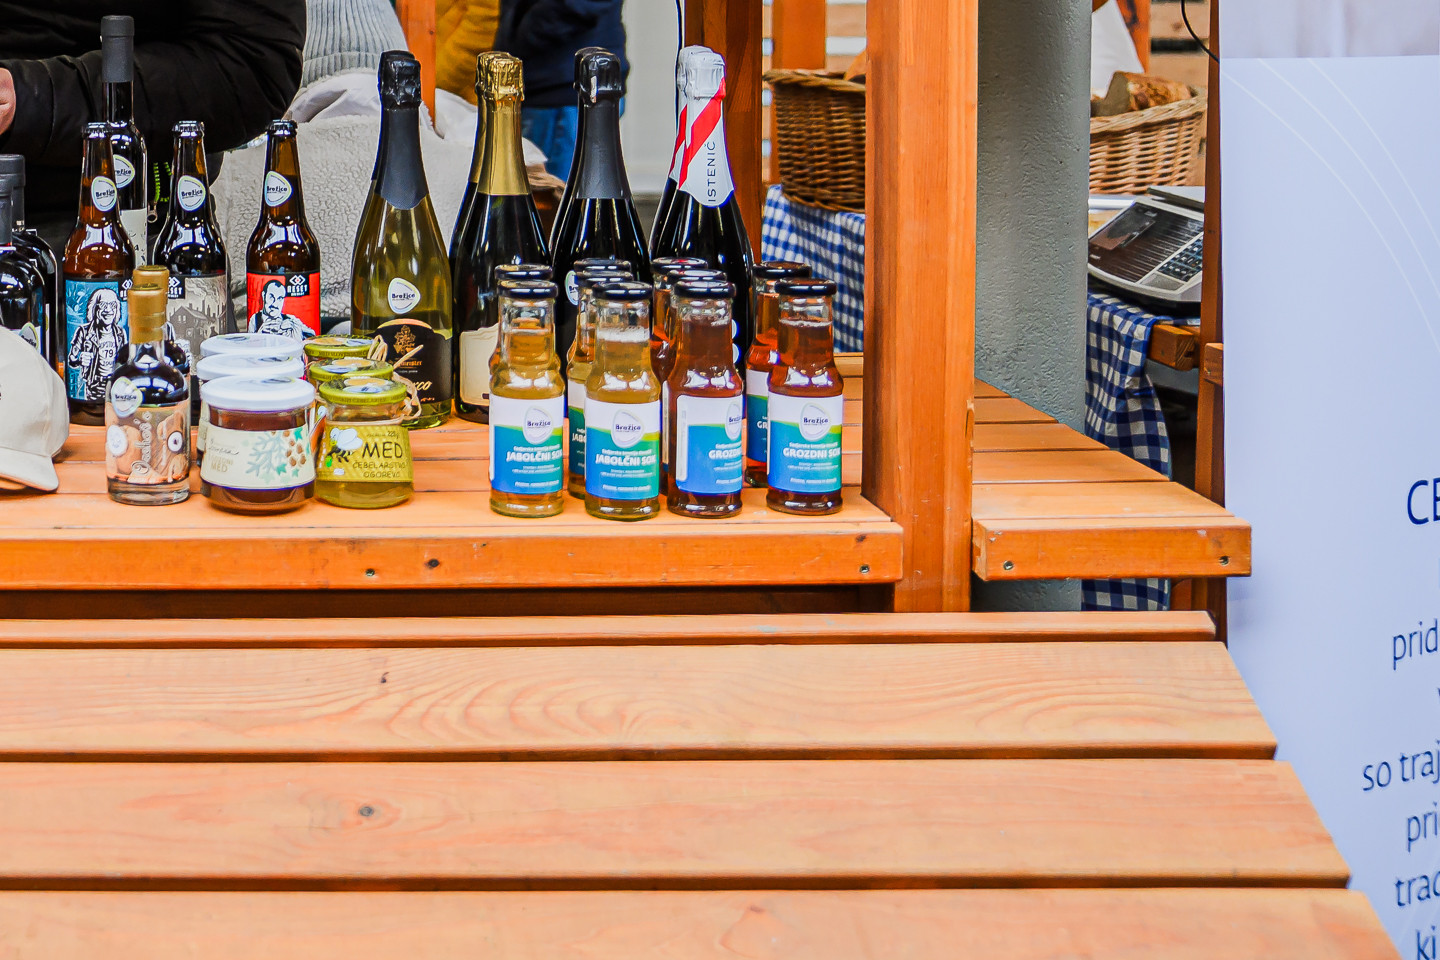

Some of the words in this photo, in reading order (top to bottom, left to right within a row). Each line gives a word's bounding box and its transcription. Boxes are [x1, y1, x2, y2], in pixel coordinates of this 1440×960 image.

[704, 141, 717, 202] ISTENIČ
[362, 441, 403, 459] MED
[506, 450, 551, 462] JABOLČNI
[595, 453, 640, 466] JABOLČNI
[782, 448, 827, 460] GROZDNI
[1407, 477, 1440, 525] CE
[1392, 618, 1440, 671] prid
[1362, 761, 1392, 791] so
[1399, 739, 1440, 785] traj
[1407, 801, 1440, 853] pri
